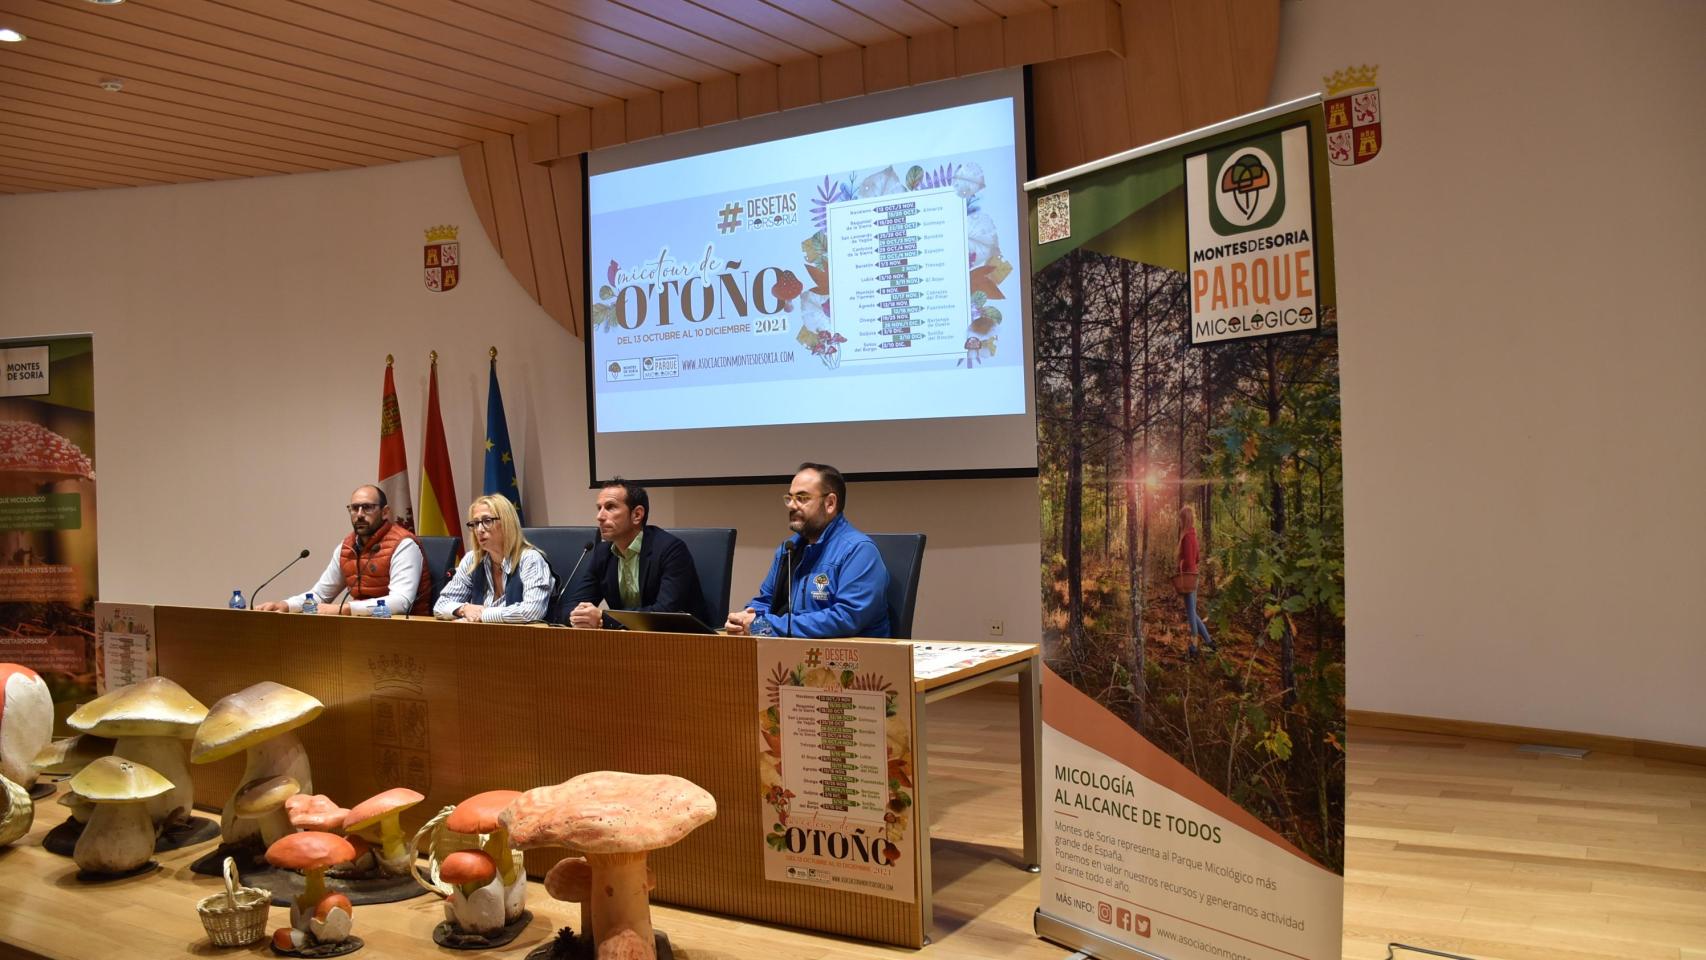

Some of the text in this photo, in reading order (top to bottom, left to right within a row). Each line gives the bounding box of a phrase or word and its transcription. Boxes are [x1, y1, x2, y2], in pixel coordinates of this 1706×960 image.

[748, 193, 796, 218] DESETAS
[1194, 230, 1309, 263] MONTESDESORIA
[616, 260, 788, 329] OTOÑO
[1194, 248, 1312, 314] PARQUE
[617, 336, 632, 345] DEL
[634, 334, 641, 344] 13
[643, 331, 680, 342] OCTUBRE
[682, 330, 693, 338] AL
[695, 329, 703, 337] 10
[705, 324, 750, 336] DICIEMBRE
[7, 362, 40, 371] MONTES
[8, 371, 44, 381] DE SORIA
[655, 360, 677, 370] PARQUE
[825, 648, 858, 662] DESETAS
[1055, 765, 1134, 797] MICOLOGÍA
[1055, 788, 1222, 844] AL ALCANCE DE TODOS
[1055, 836, 1123, 862] grande de España.
[1055, 820, 1277, 891] Montes de Soria representa al Parque Micológico más
[1055, 861, 1131, 893] durante todo el año.
[1055, 848, 1305, 931] Ponemos en valor nuestros recursos y generamos actividad
[1056, 892, 1094, 914] MÁS INFO:
